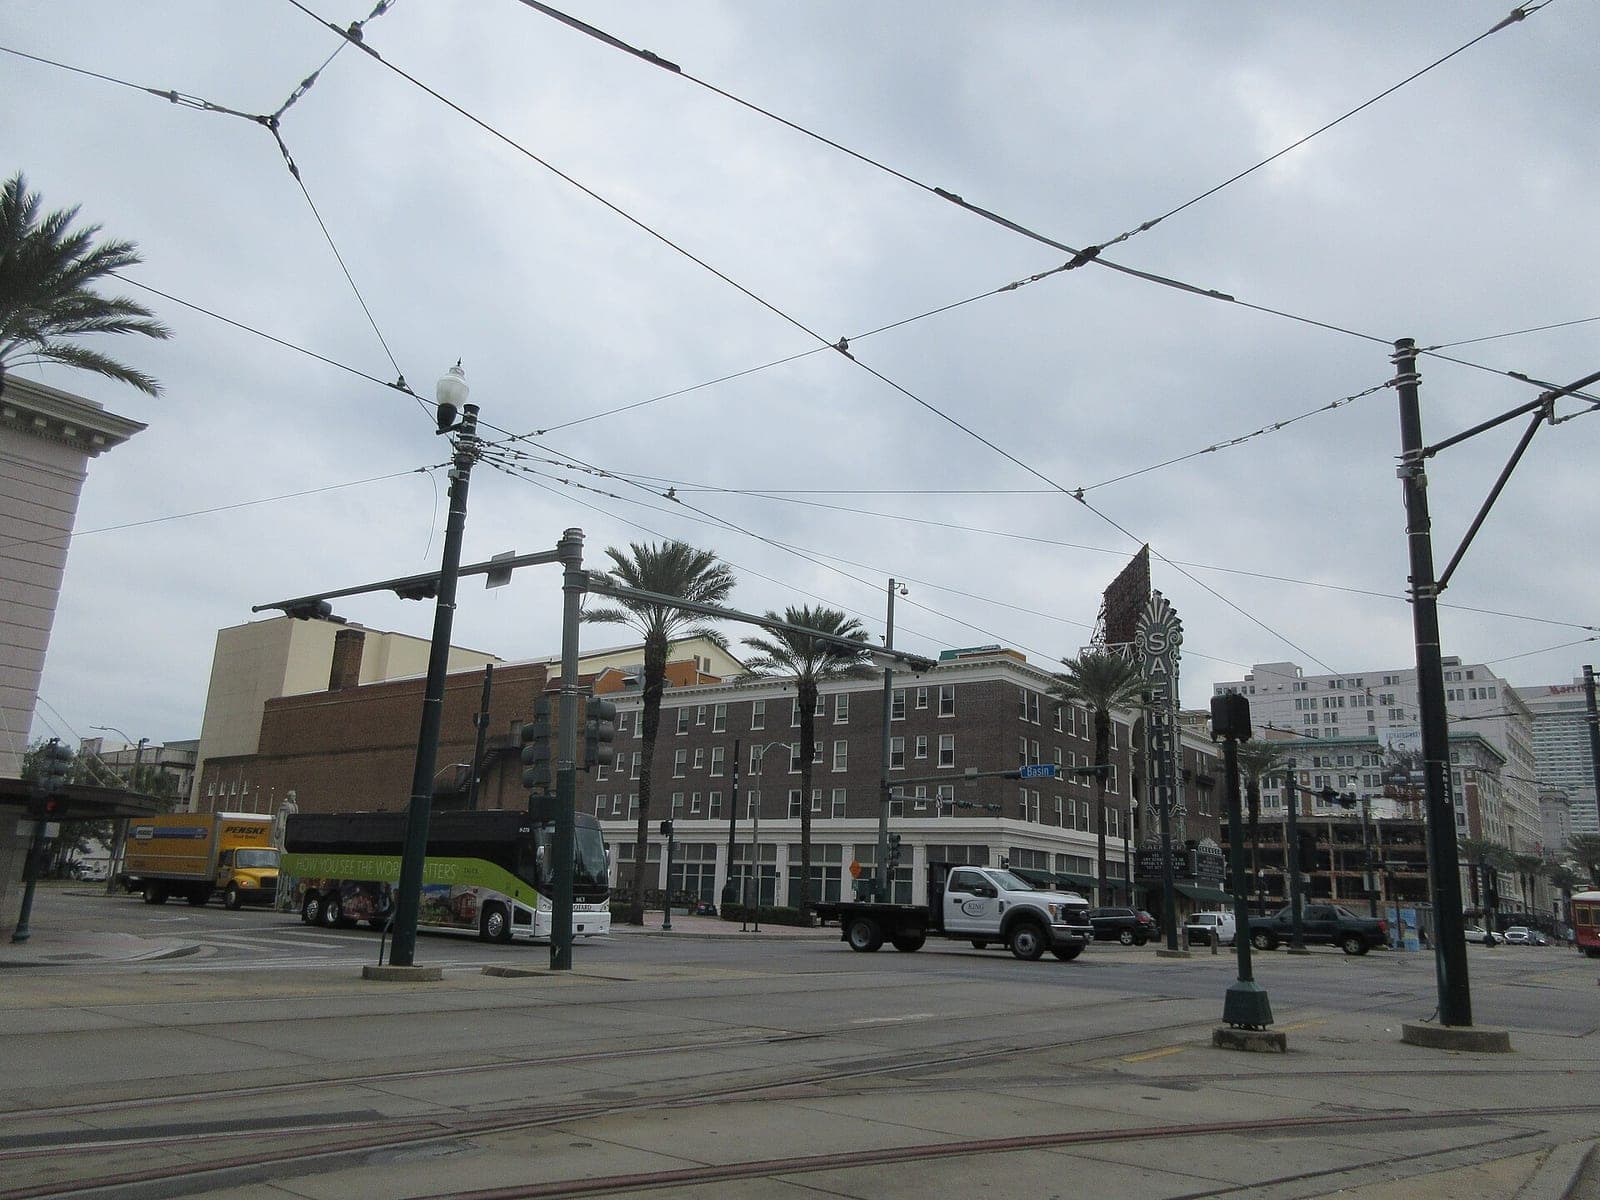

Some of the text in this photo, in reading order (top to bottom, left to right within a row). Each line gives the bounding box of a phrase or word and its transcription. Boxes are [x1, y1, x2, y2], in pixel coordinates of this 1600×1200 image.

[1026, 766, 1049, 777] Basin
[225, 826, 266, 835] PENSKE
[296, 857, 457, 879] HOW YOU SEE THE WOR ATTERS
[967, 902, 985, 910] KING
